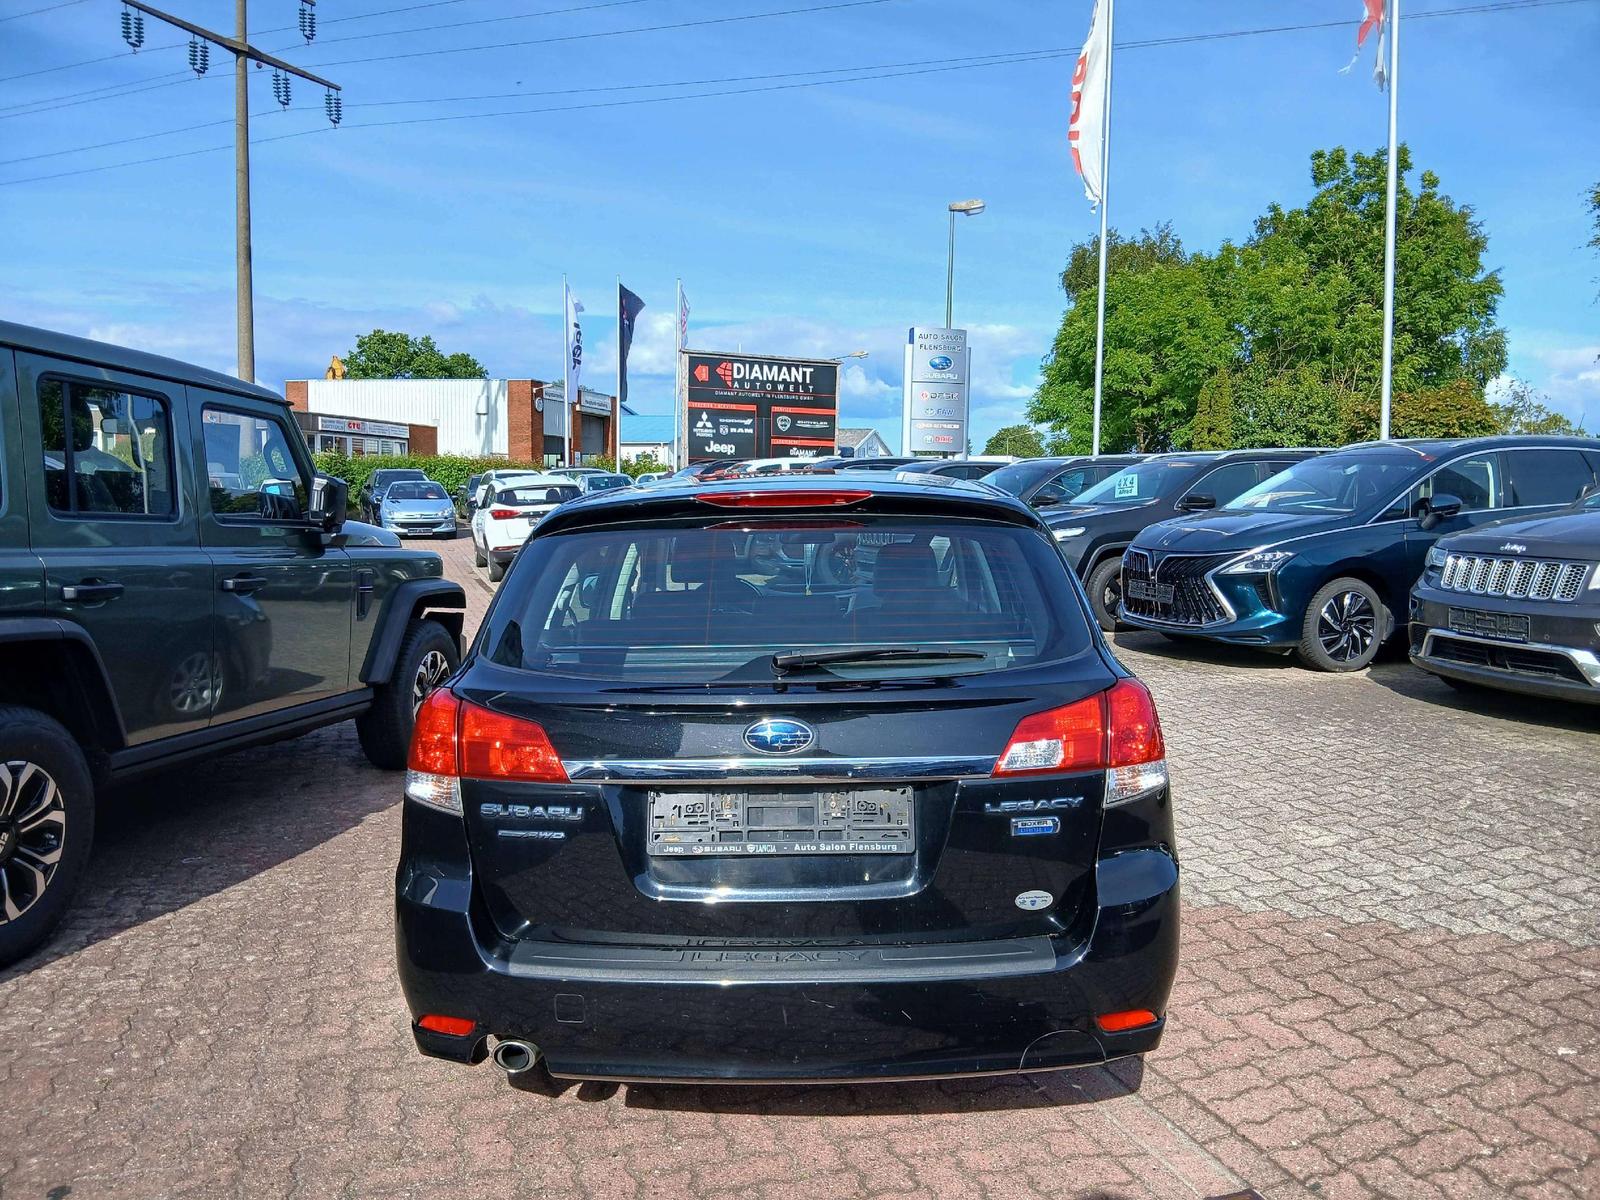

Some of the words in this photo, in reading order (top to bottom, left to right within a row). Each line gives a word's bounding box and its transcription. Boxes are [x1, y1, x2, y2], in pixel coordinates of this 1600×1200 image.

[733, 362, 814, 384] DIAMANT
[733, 382, 814, 393] AUTOWELT
[704, 440, 736, 455] Jeep
[480, 802, 583, 821] SUBARU
[984, 796, 1084, 813] LEGACY
[663, 845, 685, 854] Jeep
[704, 845, 742, 853] SUBARU
[793, 843, 817, 852] Auto
[819, 842, 847, 851] Salon
[849, 841, 898, 852] Flensburg
[691, 950, 870, 963] LEGACY
